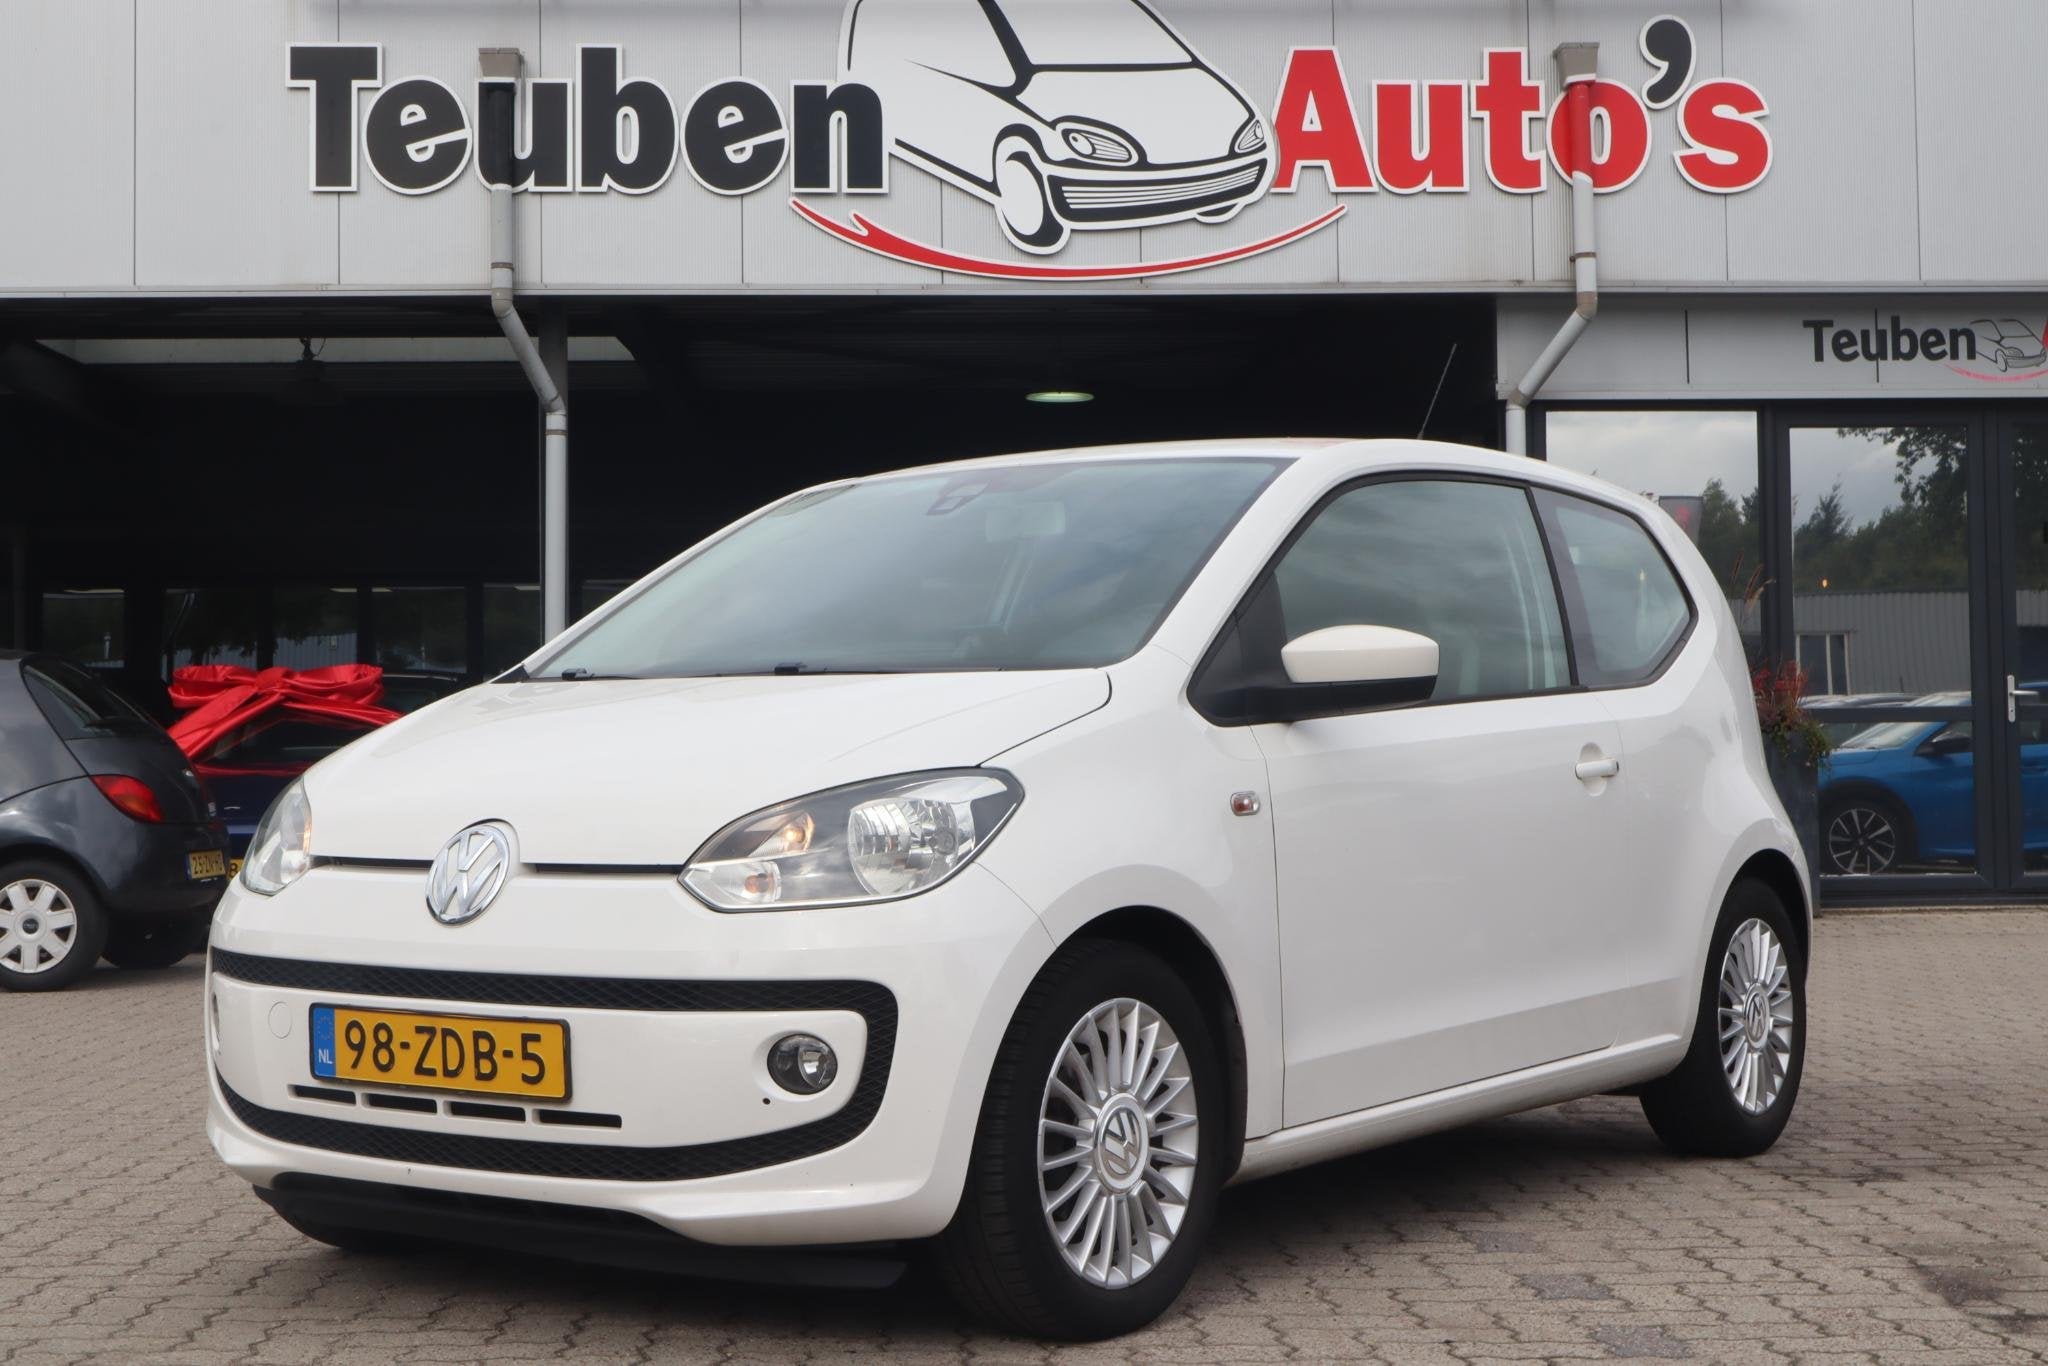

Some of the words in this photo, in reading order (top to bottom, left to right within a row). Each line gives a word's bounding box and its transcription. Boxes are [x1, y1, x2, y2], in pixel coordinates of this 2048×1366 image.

[287, 44, 887, 194] Teuben
[1271, 16, 1771, 193] Auto's
[1803, 315, 1976, 362] Teuben
[318, 1048, 333, 1065] NL
[345, 1019, 545, 1085] 98-ZDB-5
